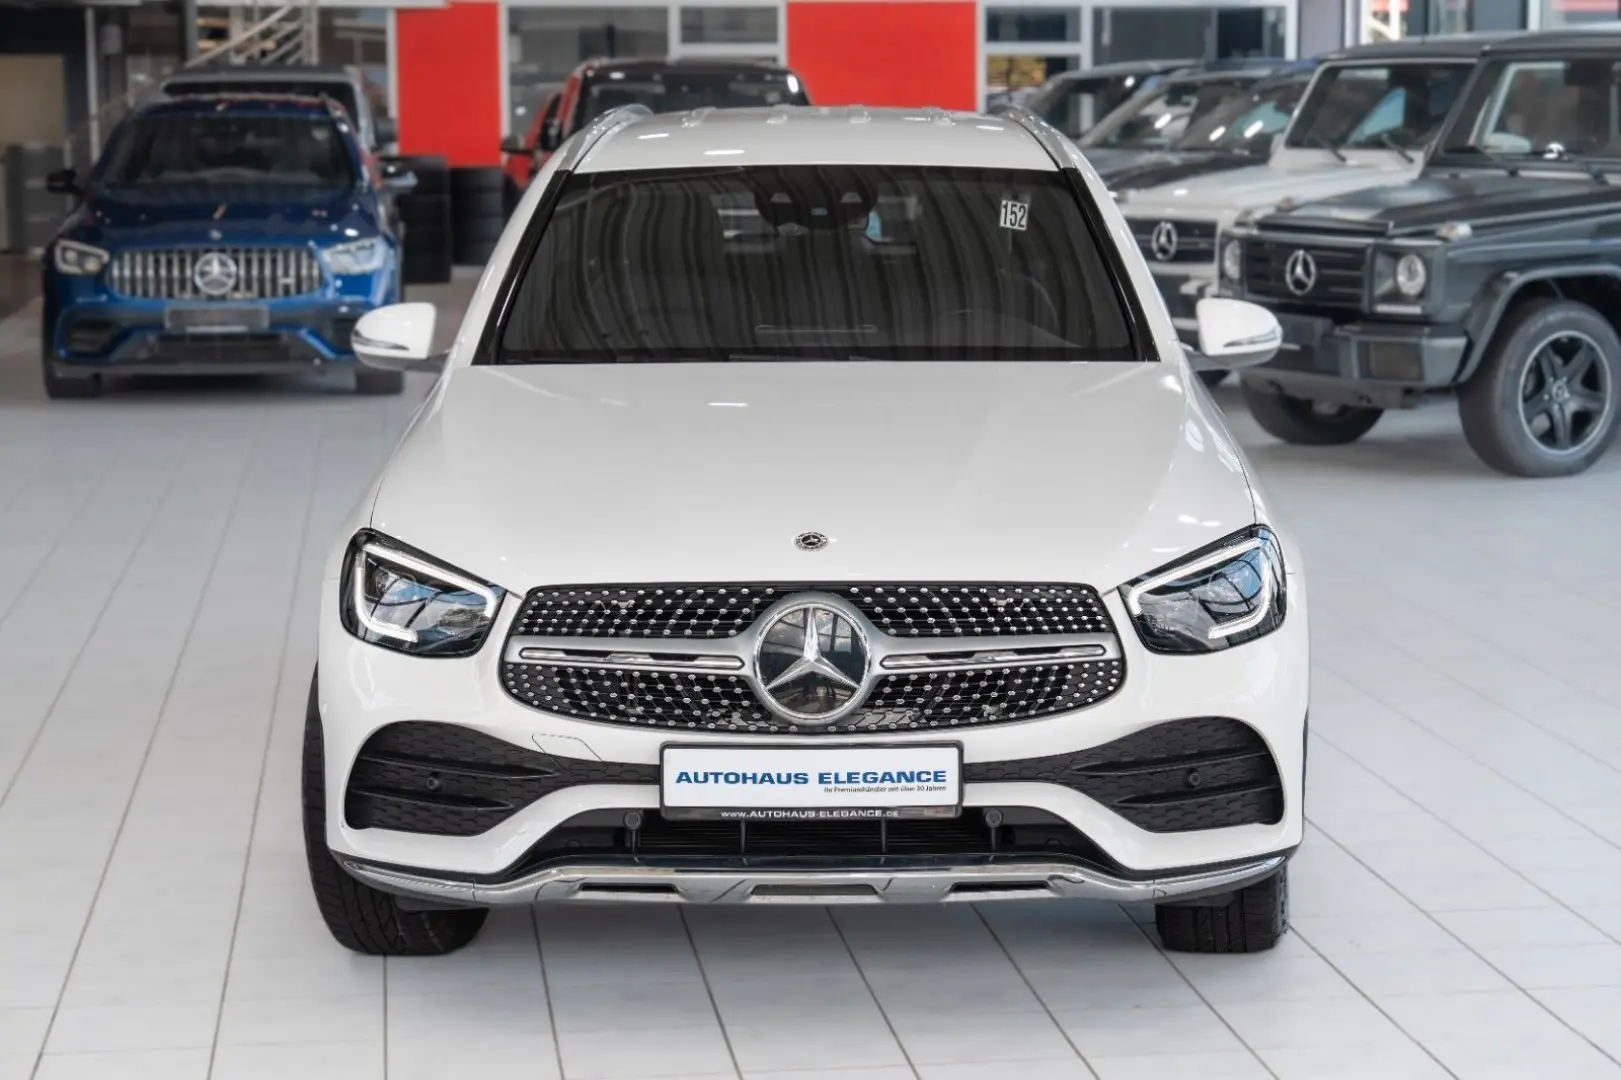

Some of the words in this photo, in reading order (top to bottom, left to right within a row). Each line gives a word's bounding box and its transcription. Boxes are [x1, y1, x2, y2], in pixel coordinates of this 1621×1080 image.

[1002, 201, 1026, 228] 152
[676, 771, 809, 785] AUTOHAUS
[818, 770, 947, 785] ELEGANCE
[926, 784, 947, 792] Jahren
